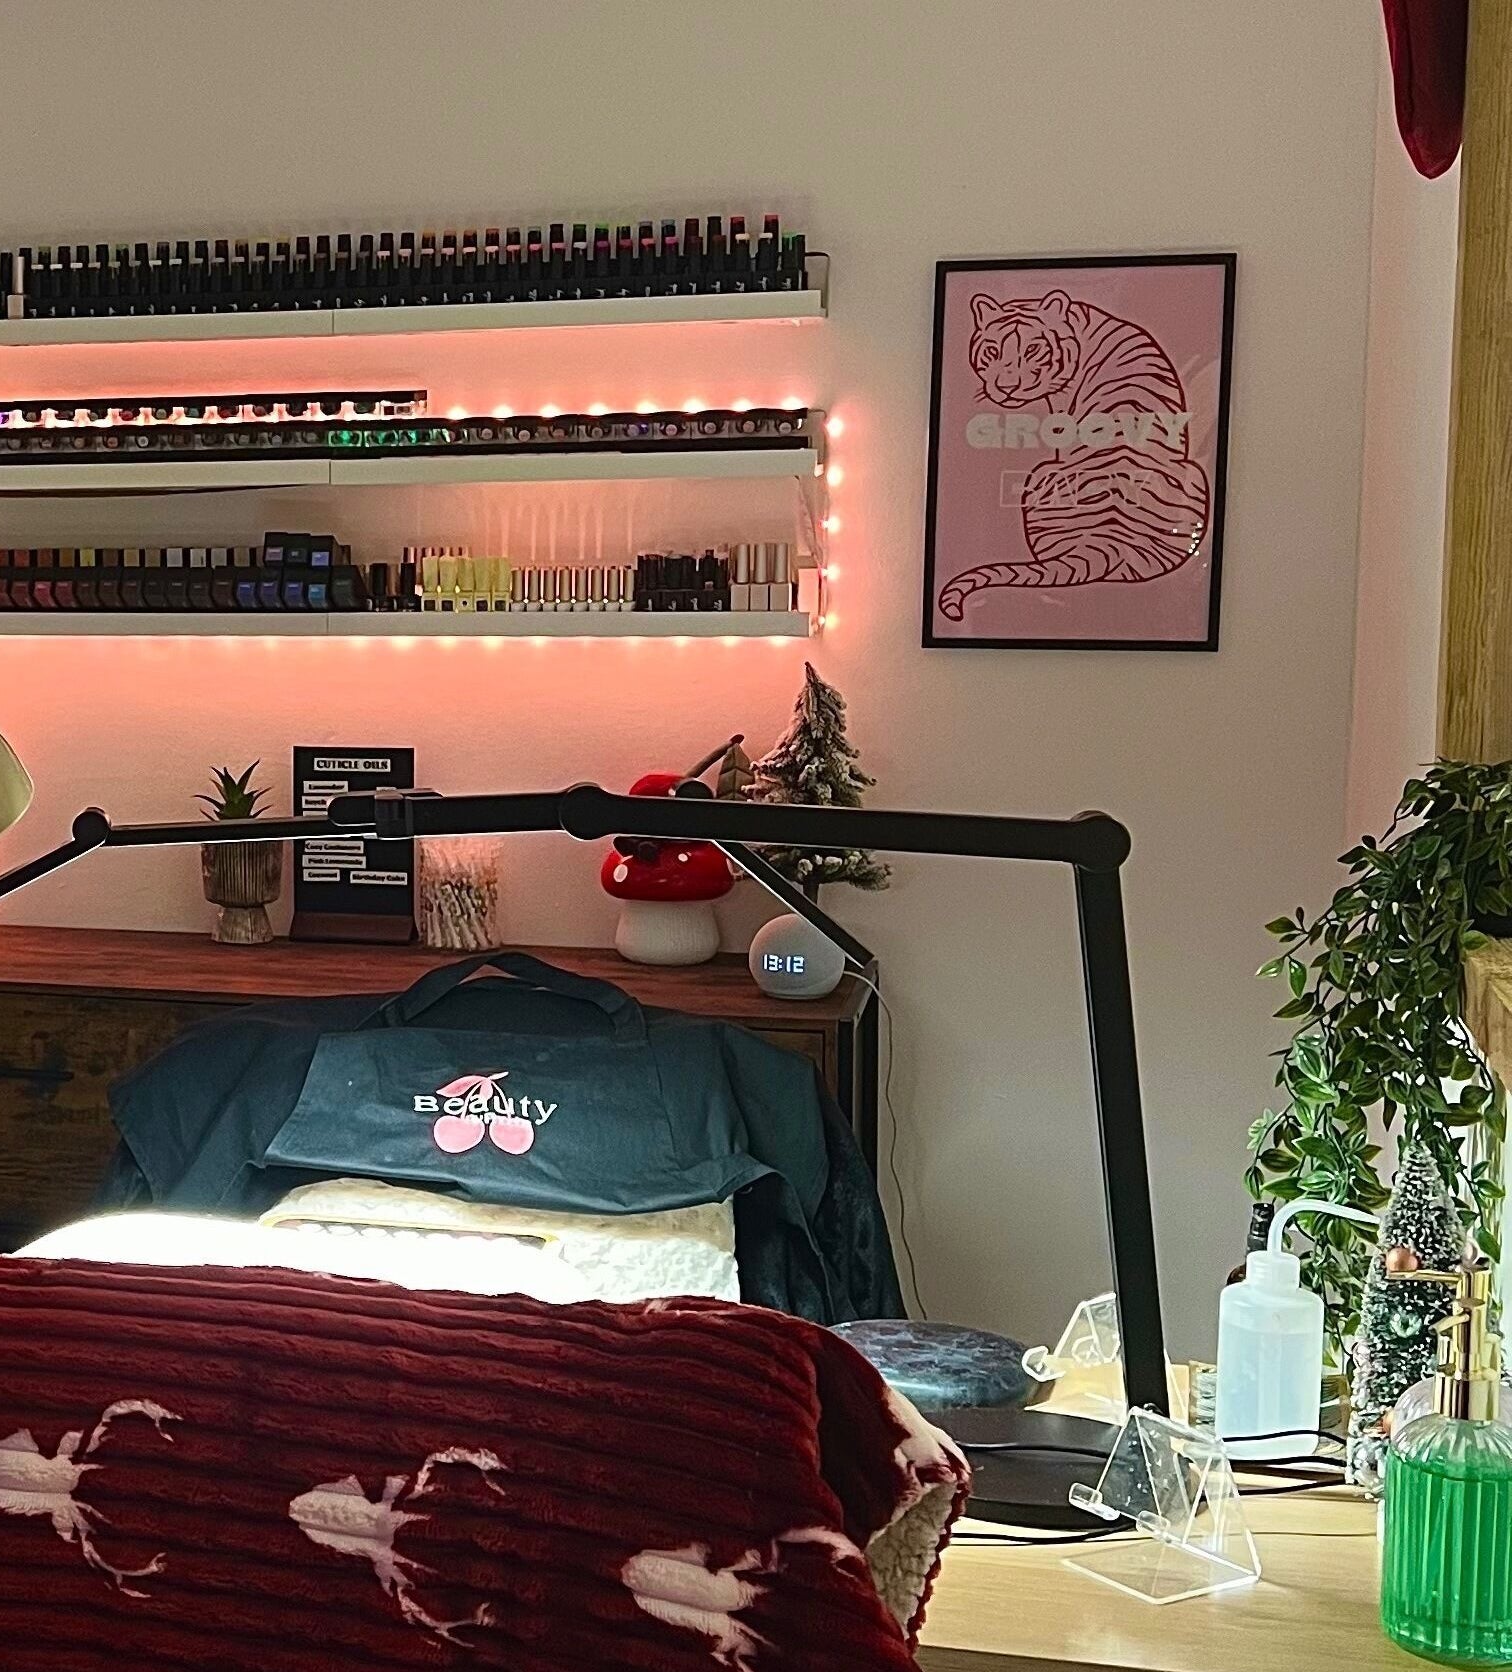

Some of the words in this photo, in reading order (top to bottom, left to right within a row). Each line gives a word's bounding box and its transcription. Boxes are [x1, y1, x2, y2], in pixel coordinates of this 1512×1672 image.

[966, 411, 1193, 450] GROOVY
[316, 760, 359, 770] CUTICLE
[363, 760, 388, 770] OILS
[763, 953, 805, 973] 13:12
[413, 1095, 558, 1126] Beauty
